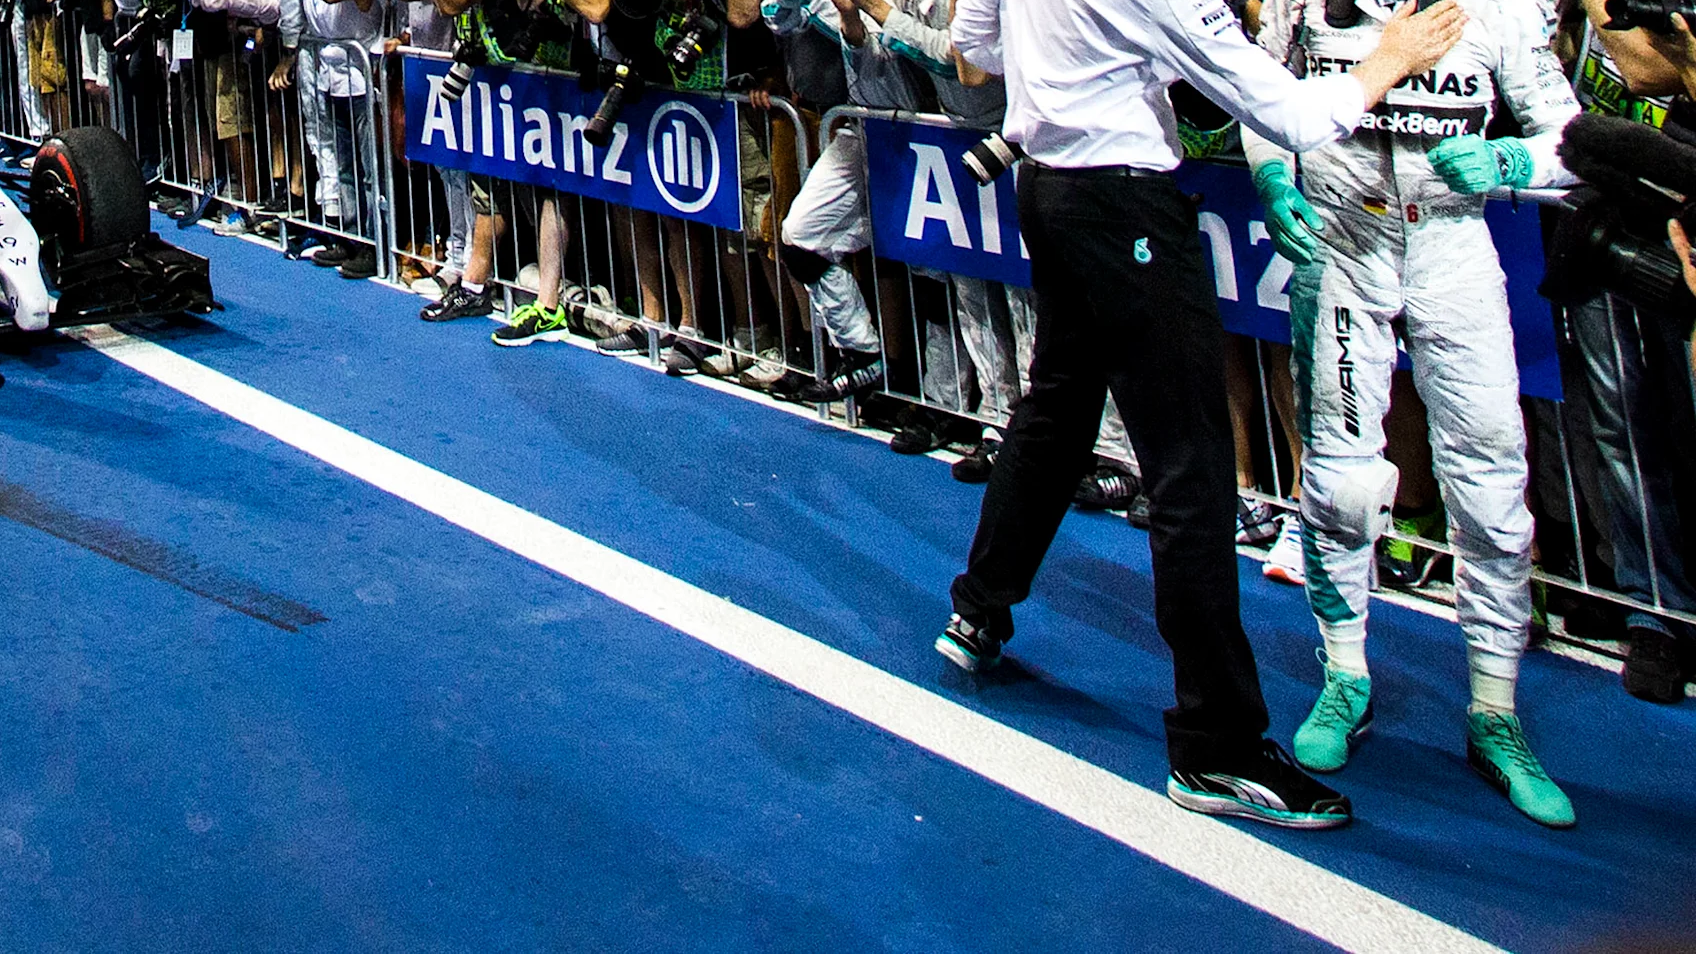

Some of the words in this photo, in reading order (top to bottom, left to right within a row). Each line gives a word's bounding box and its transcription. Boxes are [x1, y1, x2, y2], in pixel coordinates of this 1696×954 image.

[1310, 55, 1478, 98] PETNAS
[421, 74, 632, 186] Allianz
[1335, 306, 1357, 397] AMG
